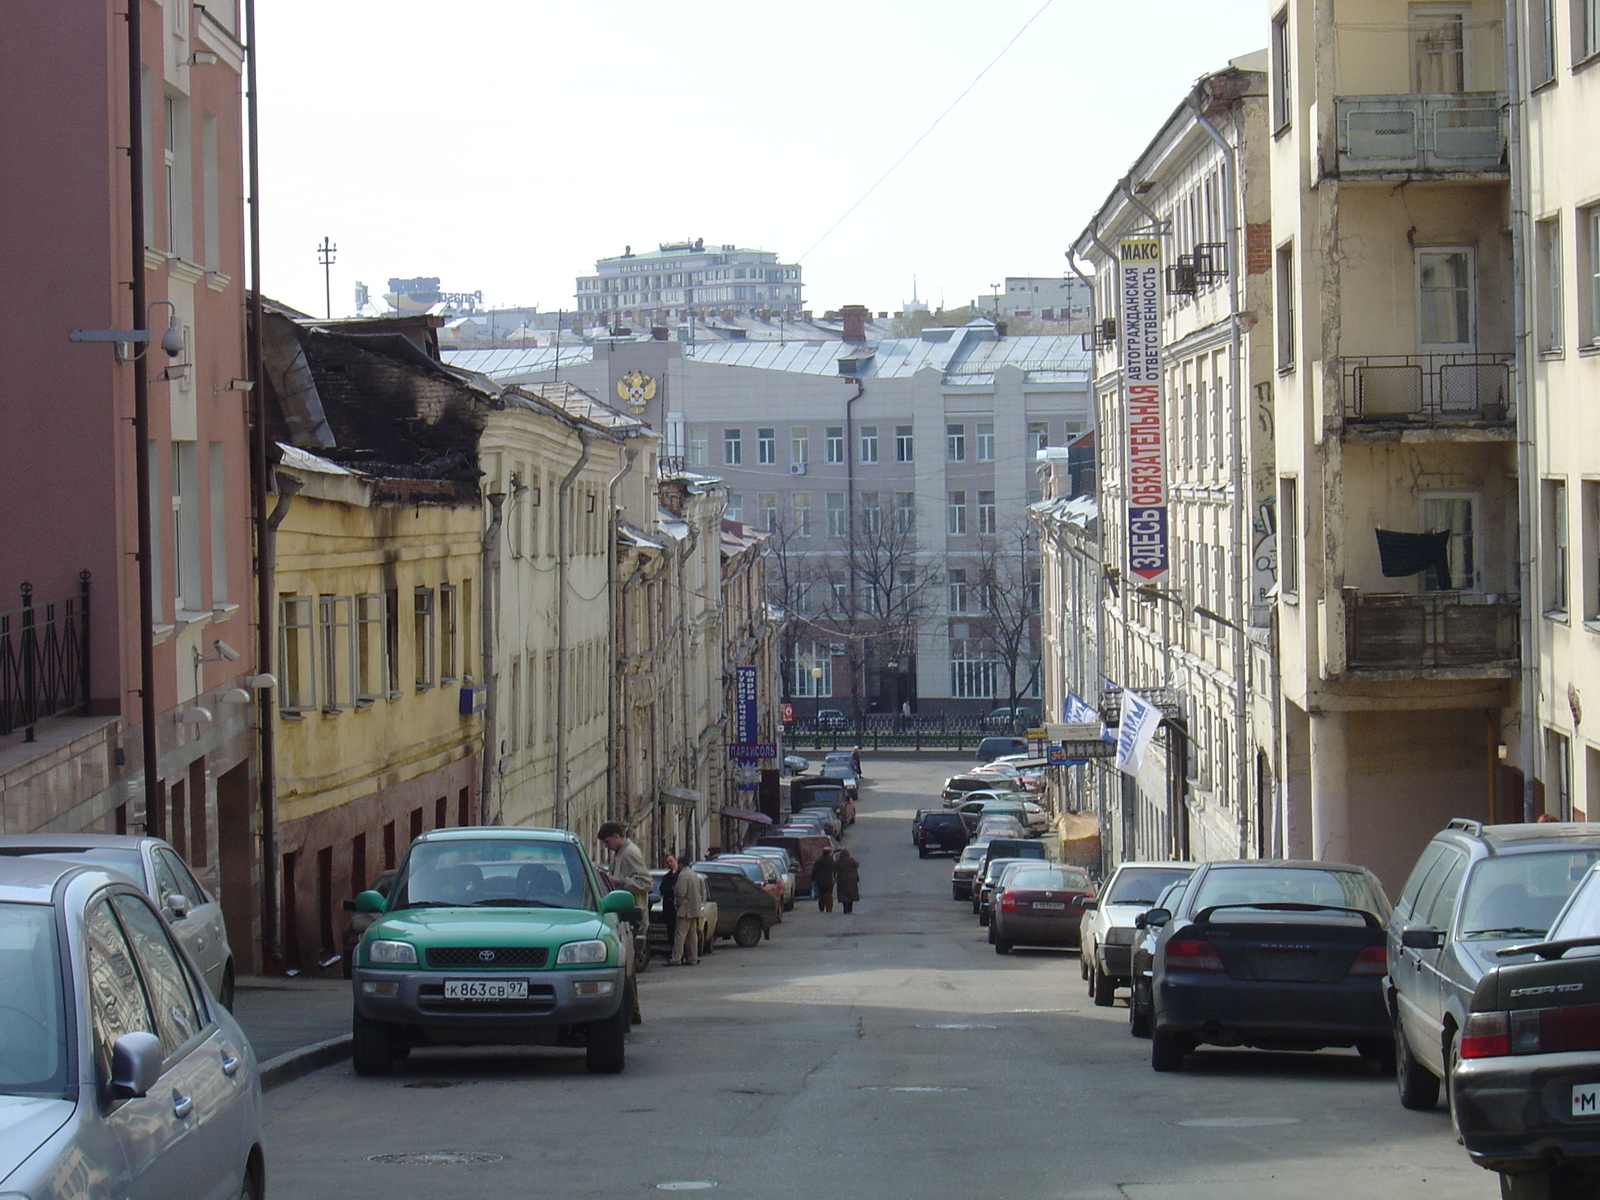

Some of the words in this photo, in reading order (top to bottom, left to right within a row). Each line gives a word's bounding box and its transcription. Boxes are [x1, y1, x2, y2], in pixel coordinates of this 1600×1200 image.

[1121, 243, 1158, 261] МАКС
[1127, 267, 1143, 381] АВТОГРАЖДАНСКАЯ
[1145, 267, 1157, 381] ОТВЕТСТВЕННОСТЬ
[1130, 385, 1161, 506] ОБЯЗАТЕЛЬНАЯ
[1131, 510, 1163, 568] ЗДЕСЬ
[509, 982, 523, 993] 97
